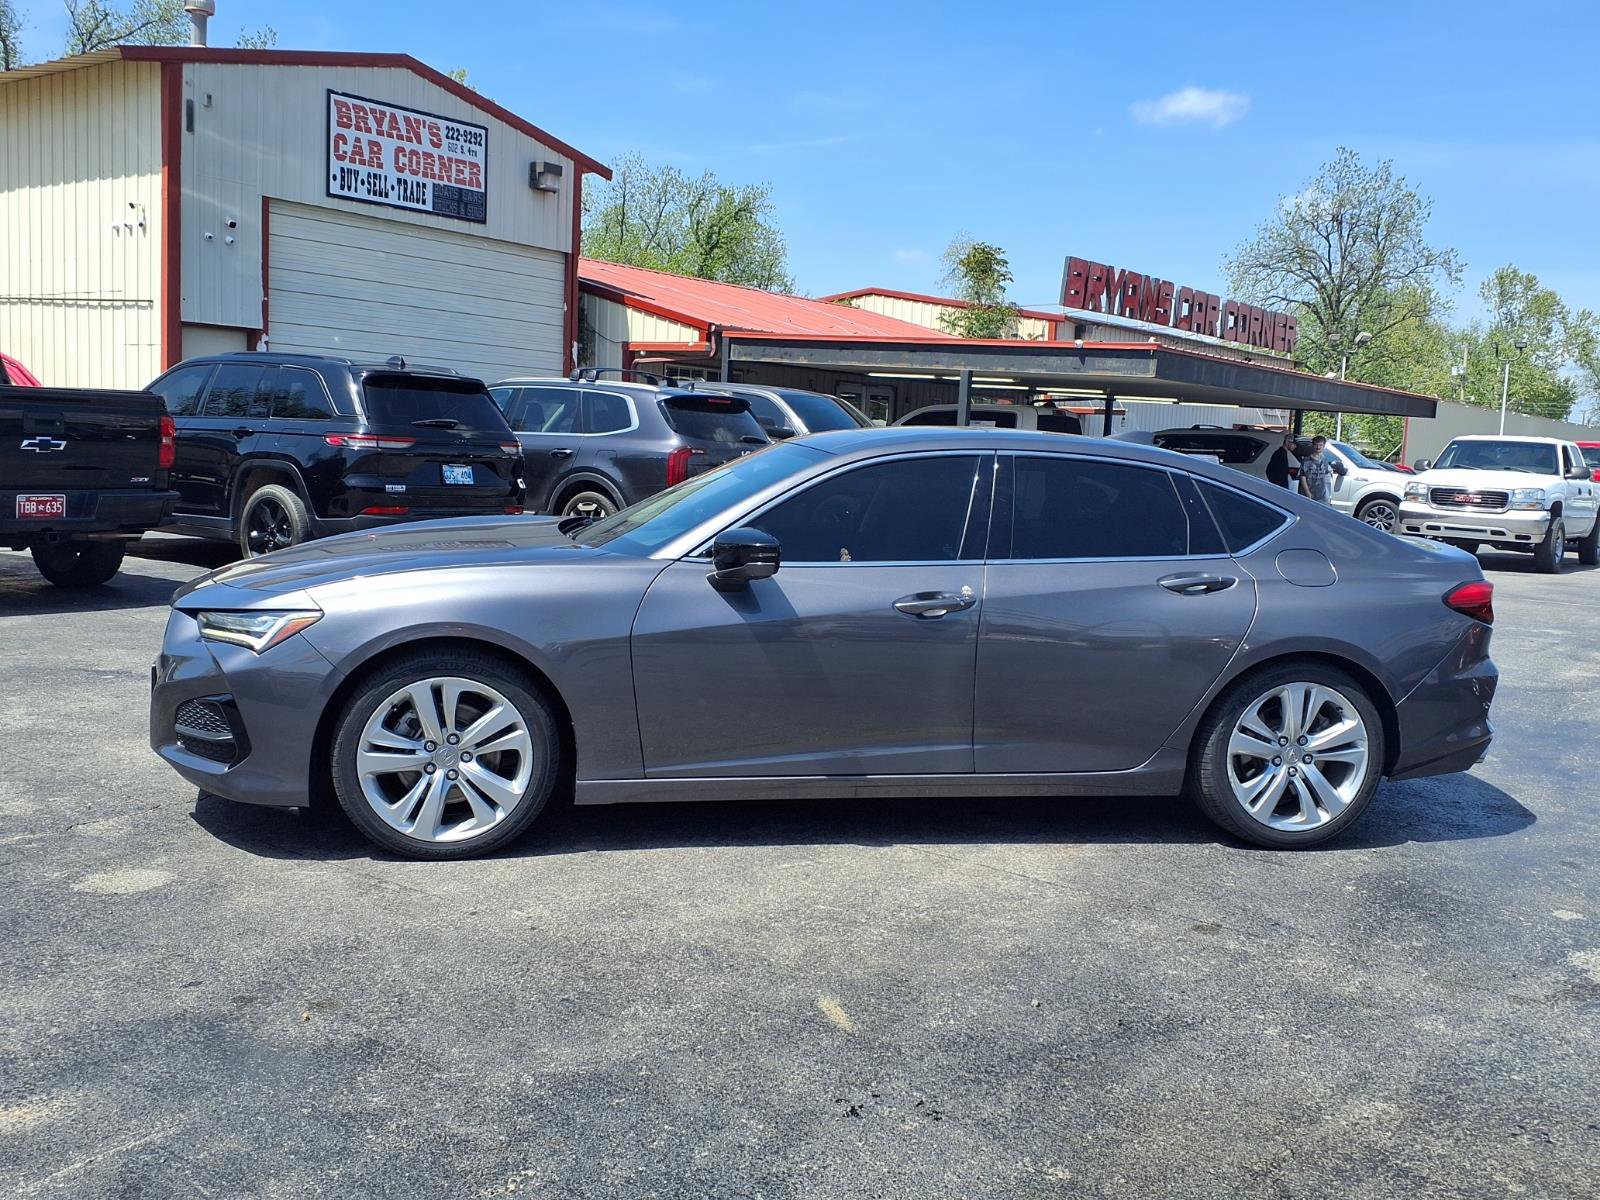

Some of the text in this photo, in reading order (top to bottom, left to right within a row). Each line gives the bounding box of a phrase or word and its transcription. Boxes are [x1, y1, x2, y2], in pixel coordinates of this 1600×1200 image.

[334, 99, 443, 149] BRYAN'S
[445, 125, 483, 147] 222-9292
[334, 133, 482, 189] CAR CORNER
[339, 166, 427, 206] BUY SELL TRADE
[1060, 256, 1297, 353] BRYANS CAR CORNER
[20, 501, 63, 513] TBB 635
